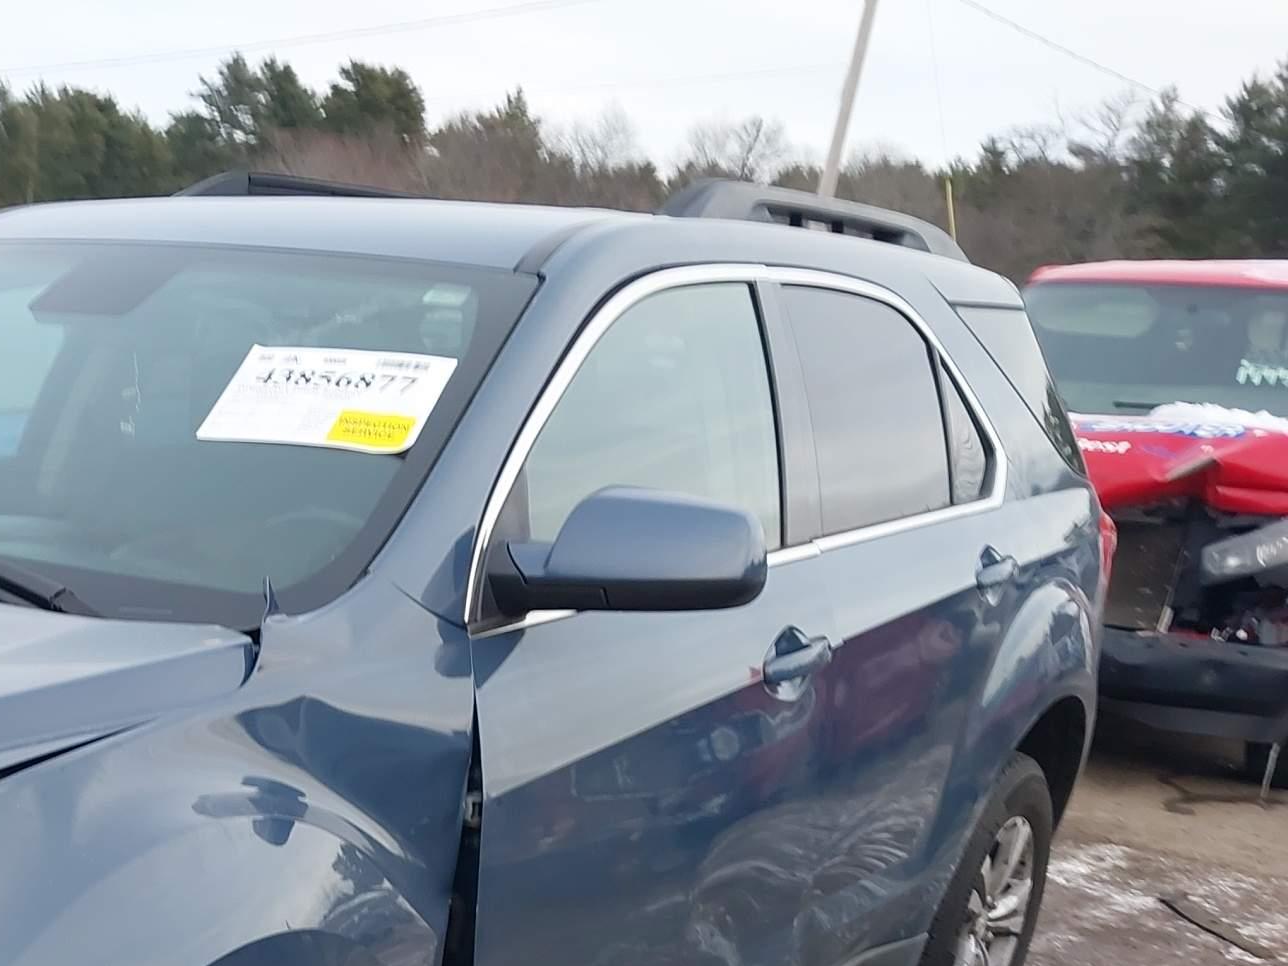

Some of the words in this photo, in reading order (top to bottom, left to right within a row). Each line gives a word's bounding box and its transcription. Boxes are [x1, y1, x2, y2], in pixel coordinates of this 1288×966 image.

[255, 367, 418, 394] 43856877
[339, 416, 410, 432] INSPECTION
[342, 426, 392, 440] SERVICE
